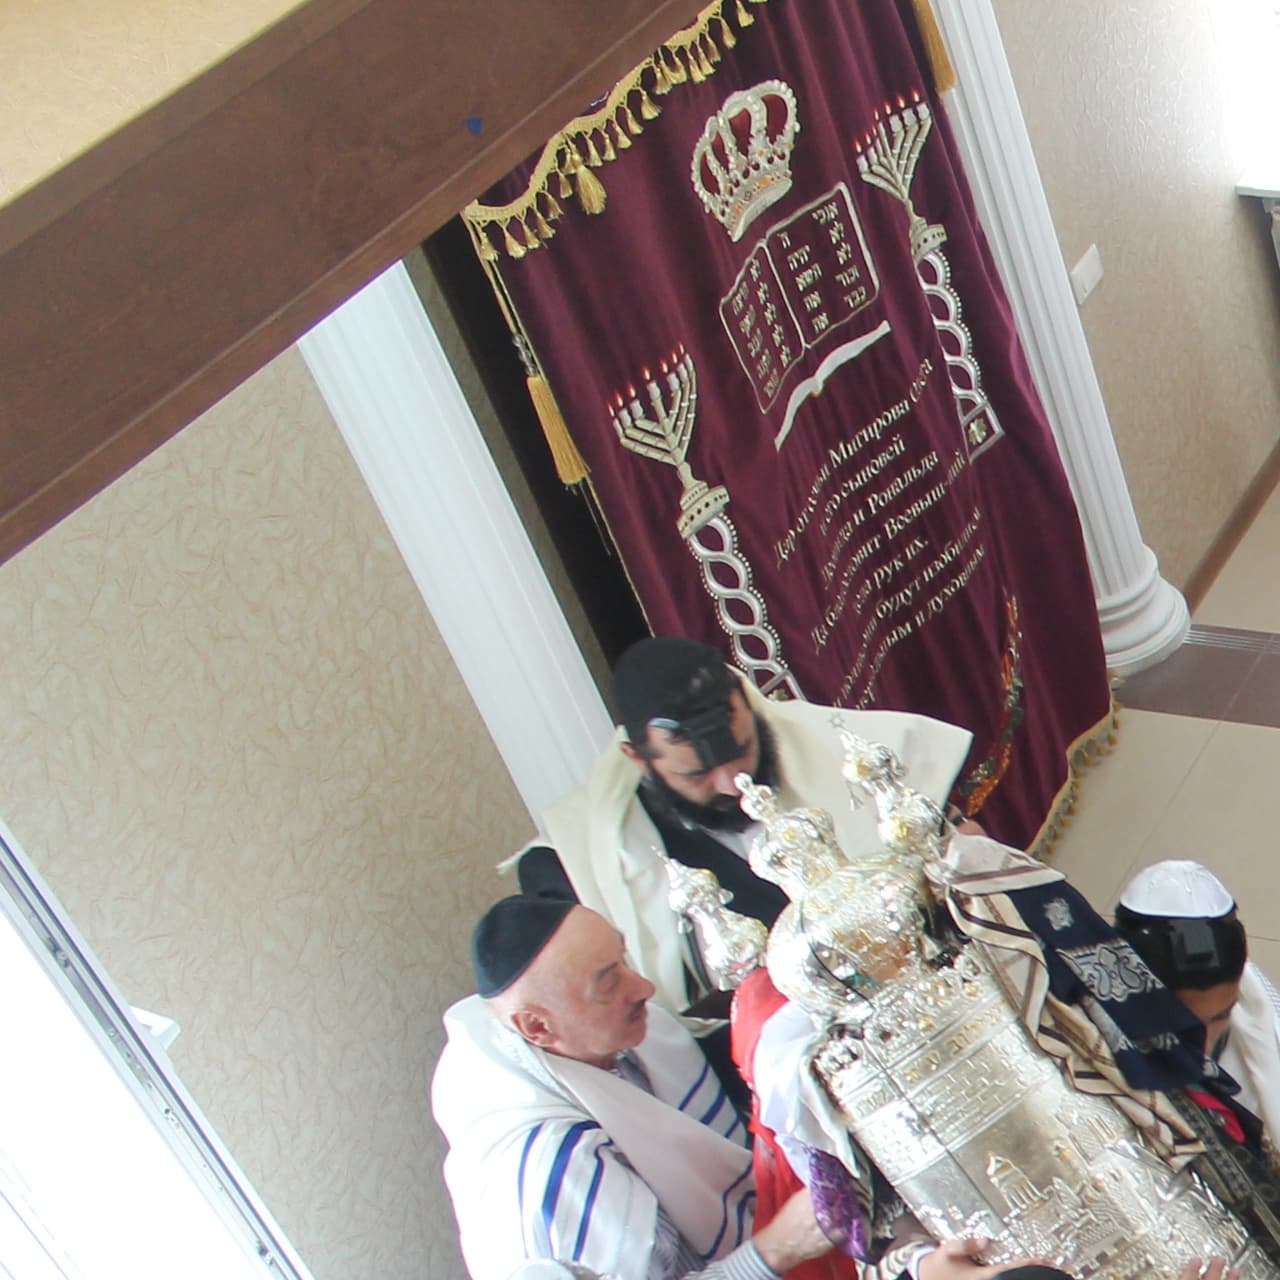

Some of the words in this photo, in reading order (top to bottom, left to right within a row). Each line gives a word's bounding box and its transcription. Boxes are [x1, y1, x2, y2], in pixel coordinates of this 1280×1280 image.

[829, 221, 844, 244] לא
[787, 245, 810, 271] יהיה
[836, 242, 851, 265] לא
[828, 399, 911, 469] Мигирова
[840, 433, 907, 498] сыновей
[853, 509, 866, 526] и
[866, 451, 939, 516] Рональда
[873, 554, 904, 589] рук
[875, 575, 921, 619] будут
[914, 611, 925, 628] и
